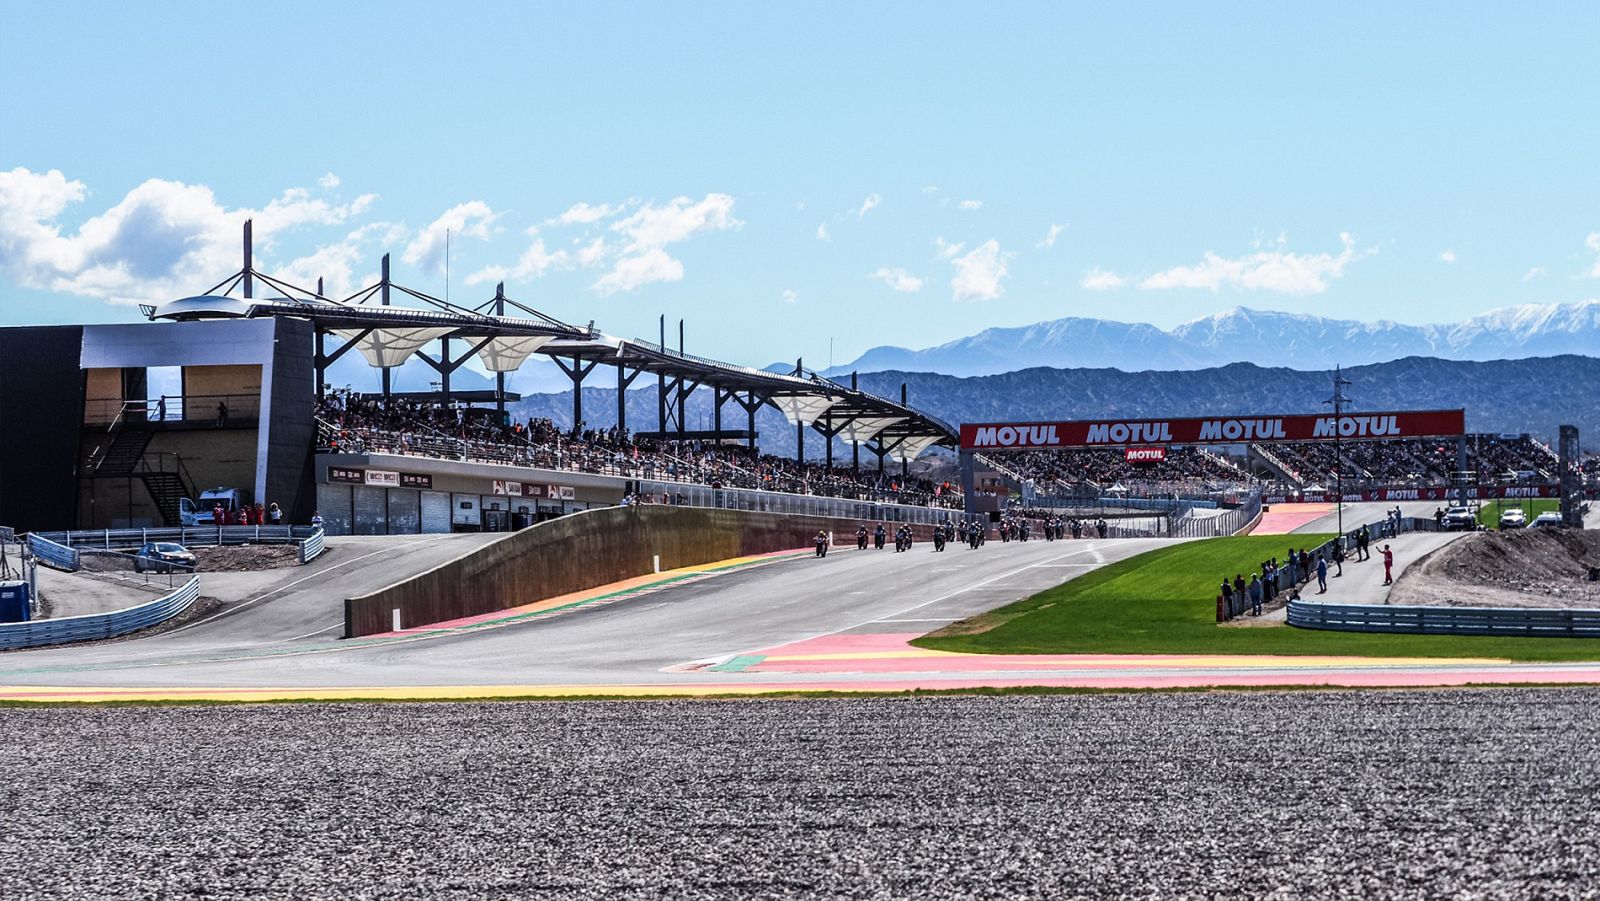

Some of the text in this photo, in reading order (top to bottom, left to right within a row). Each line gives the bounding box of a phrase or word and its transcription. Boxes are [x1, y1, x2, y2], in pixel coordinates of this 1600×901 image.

[973, 415, 1401, 446] MOTUL MOTUL MOTUL MOTUL
[1127, 450, 1164, 460] MOTUL
[1342, 494, 1362, 502] MOTUL
[1386, 489, 1419, 499] MOTUL
[1504, 487, 1540, 497] MOTUL
